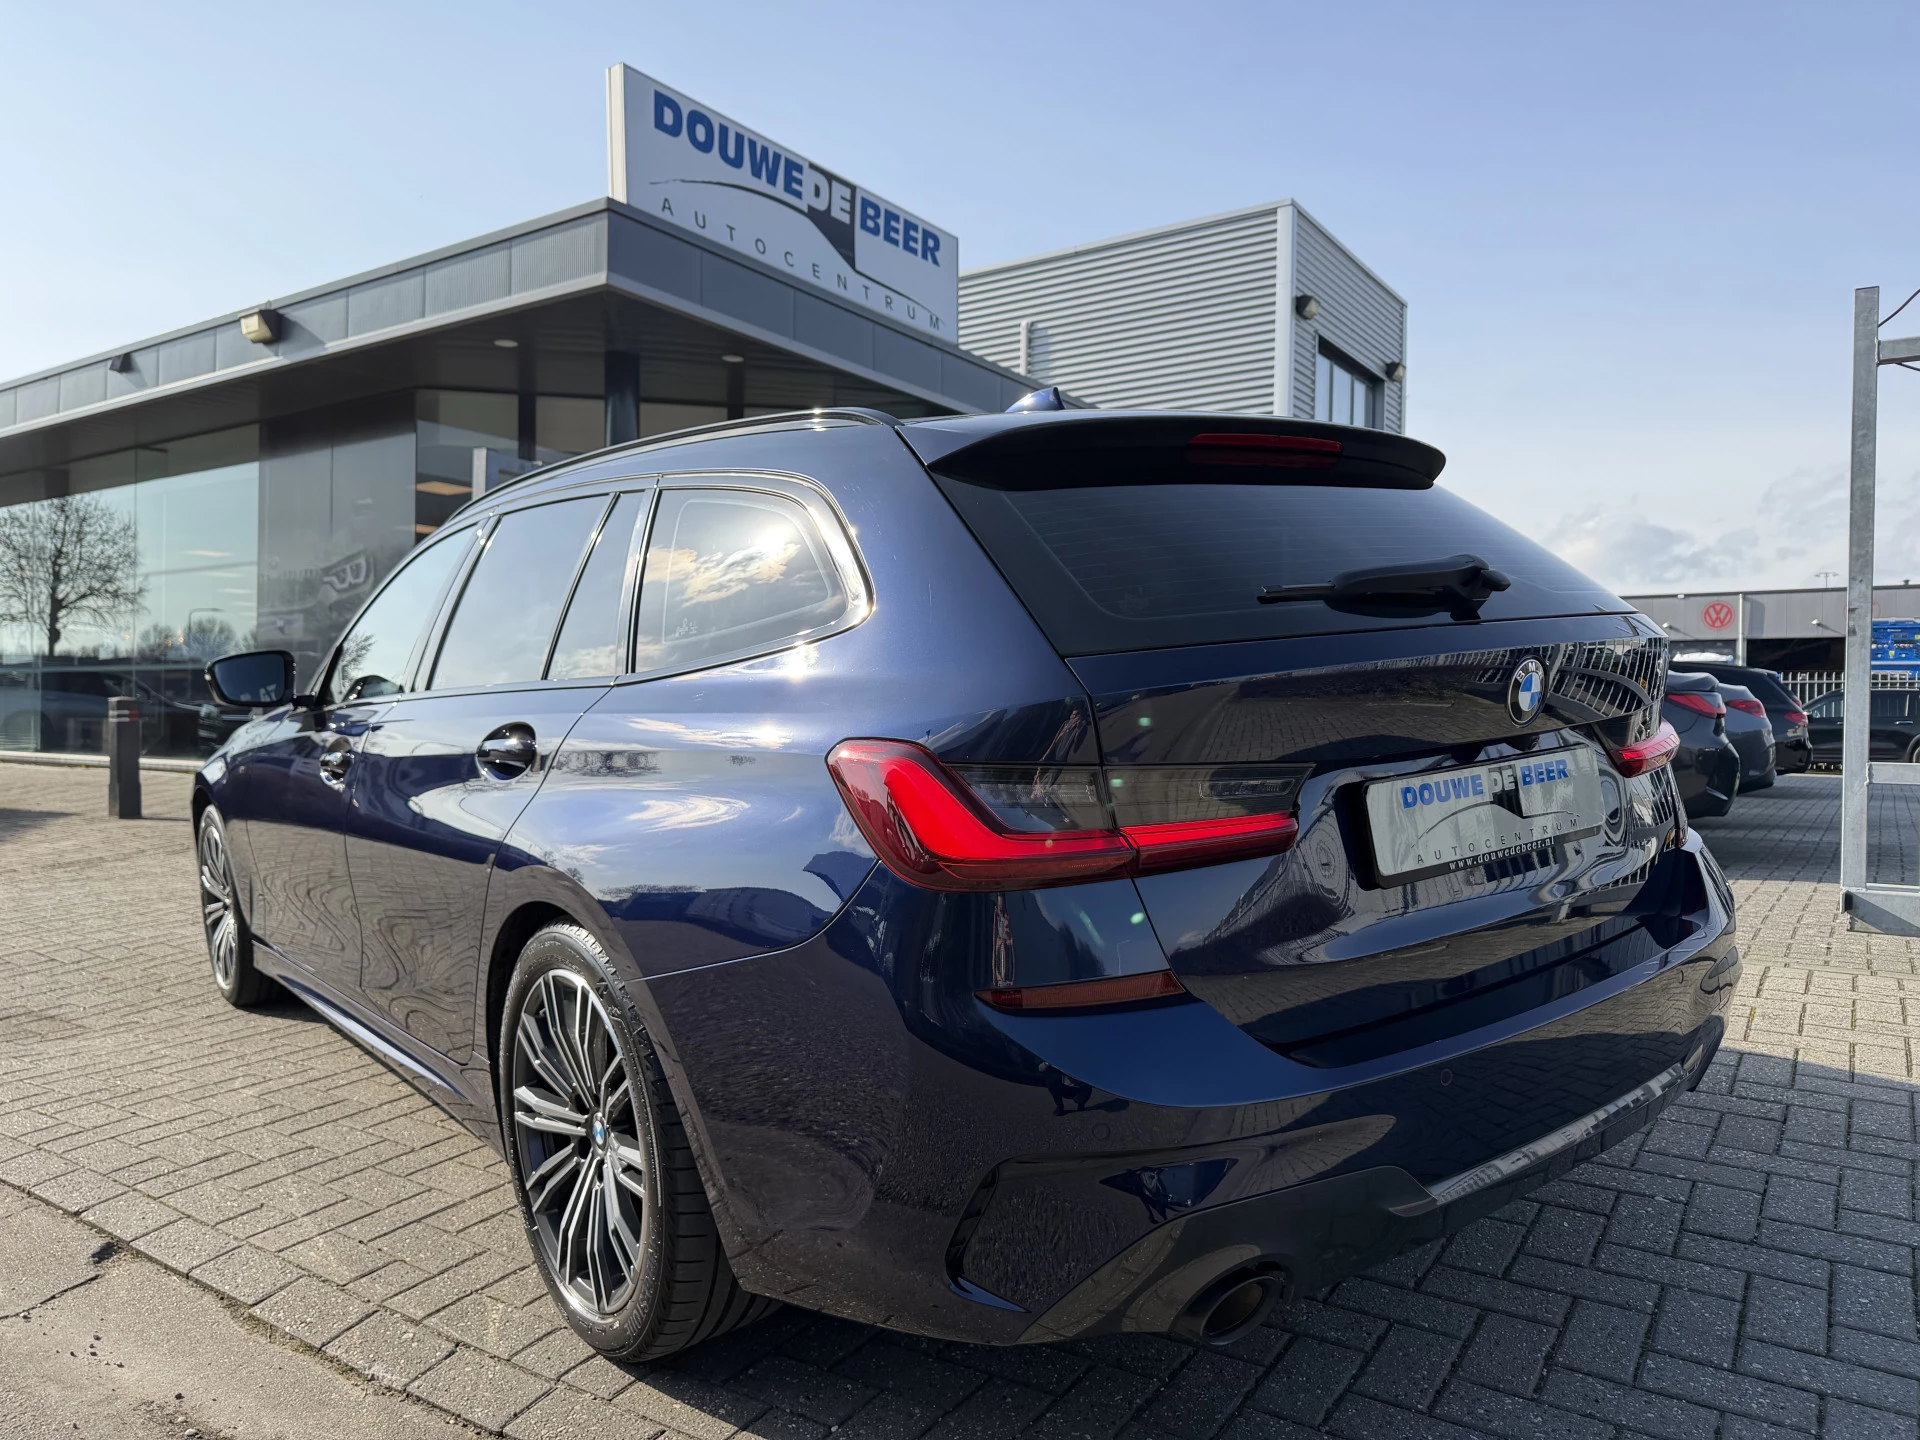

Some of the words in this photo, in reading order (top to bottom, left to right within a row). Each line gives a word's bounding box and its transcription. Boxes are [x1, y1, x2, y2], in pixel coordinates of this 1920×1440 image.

[653, 88, 804, 200] DOUWE
[803, 161, 851, 225] DE
[859, 196, 941, 267] BEER
[661, 197, 940, 332] AUTOCENTRUM
[1400, 773, 1485, 809] DOUWE
[1488, 768, 1516, 793] DE
[1519, 758, 1570, 787] BEER
[1416, 818, 1578, 865] AUTOCENTRUM
[1448, 835, 1556, 871] www.douwedebeer.nl
